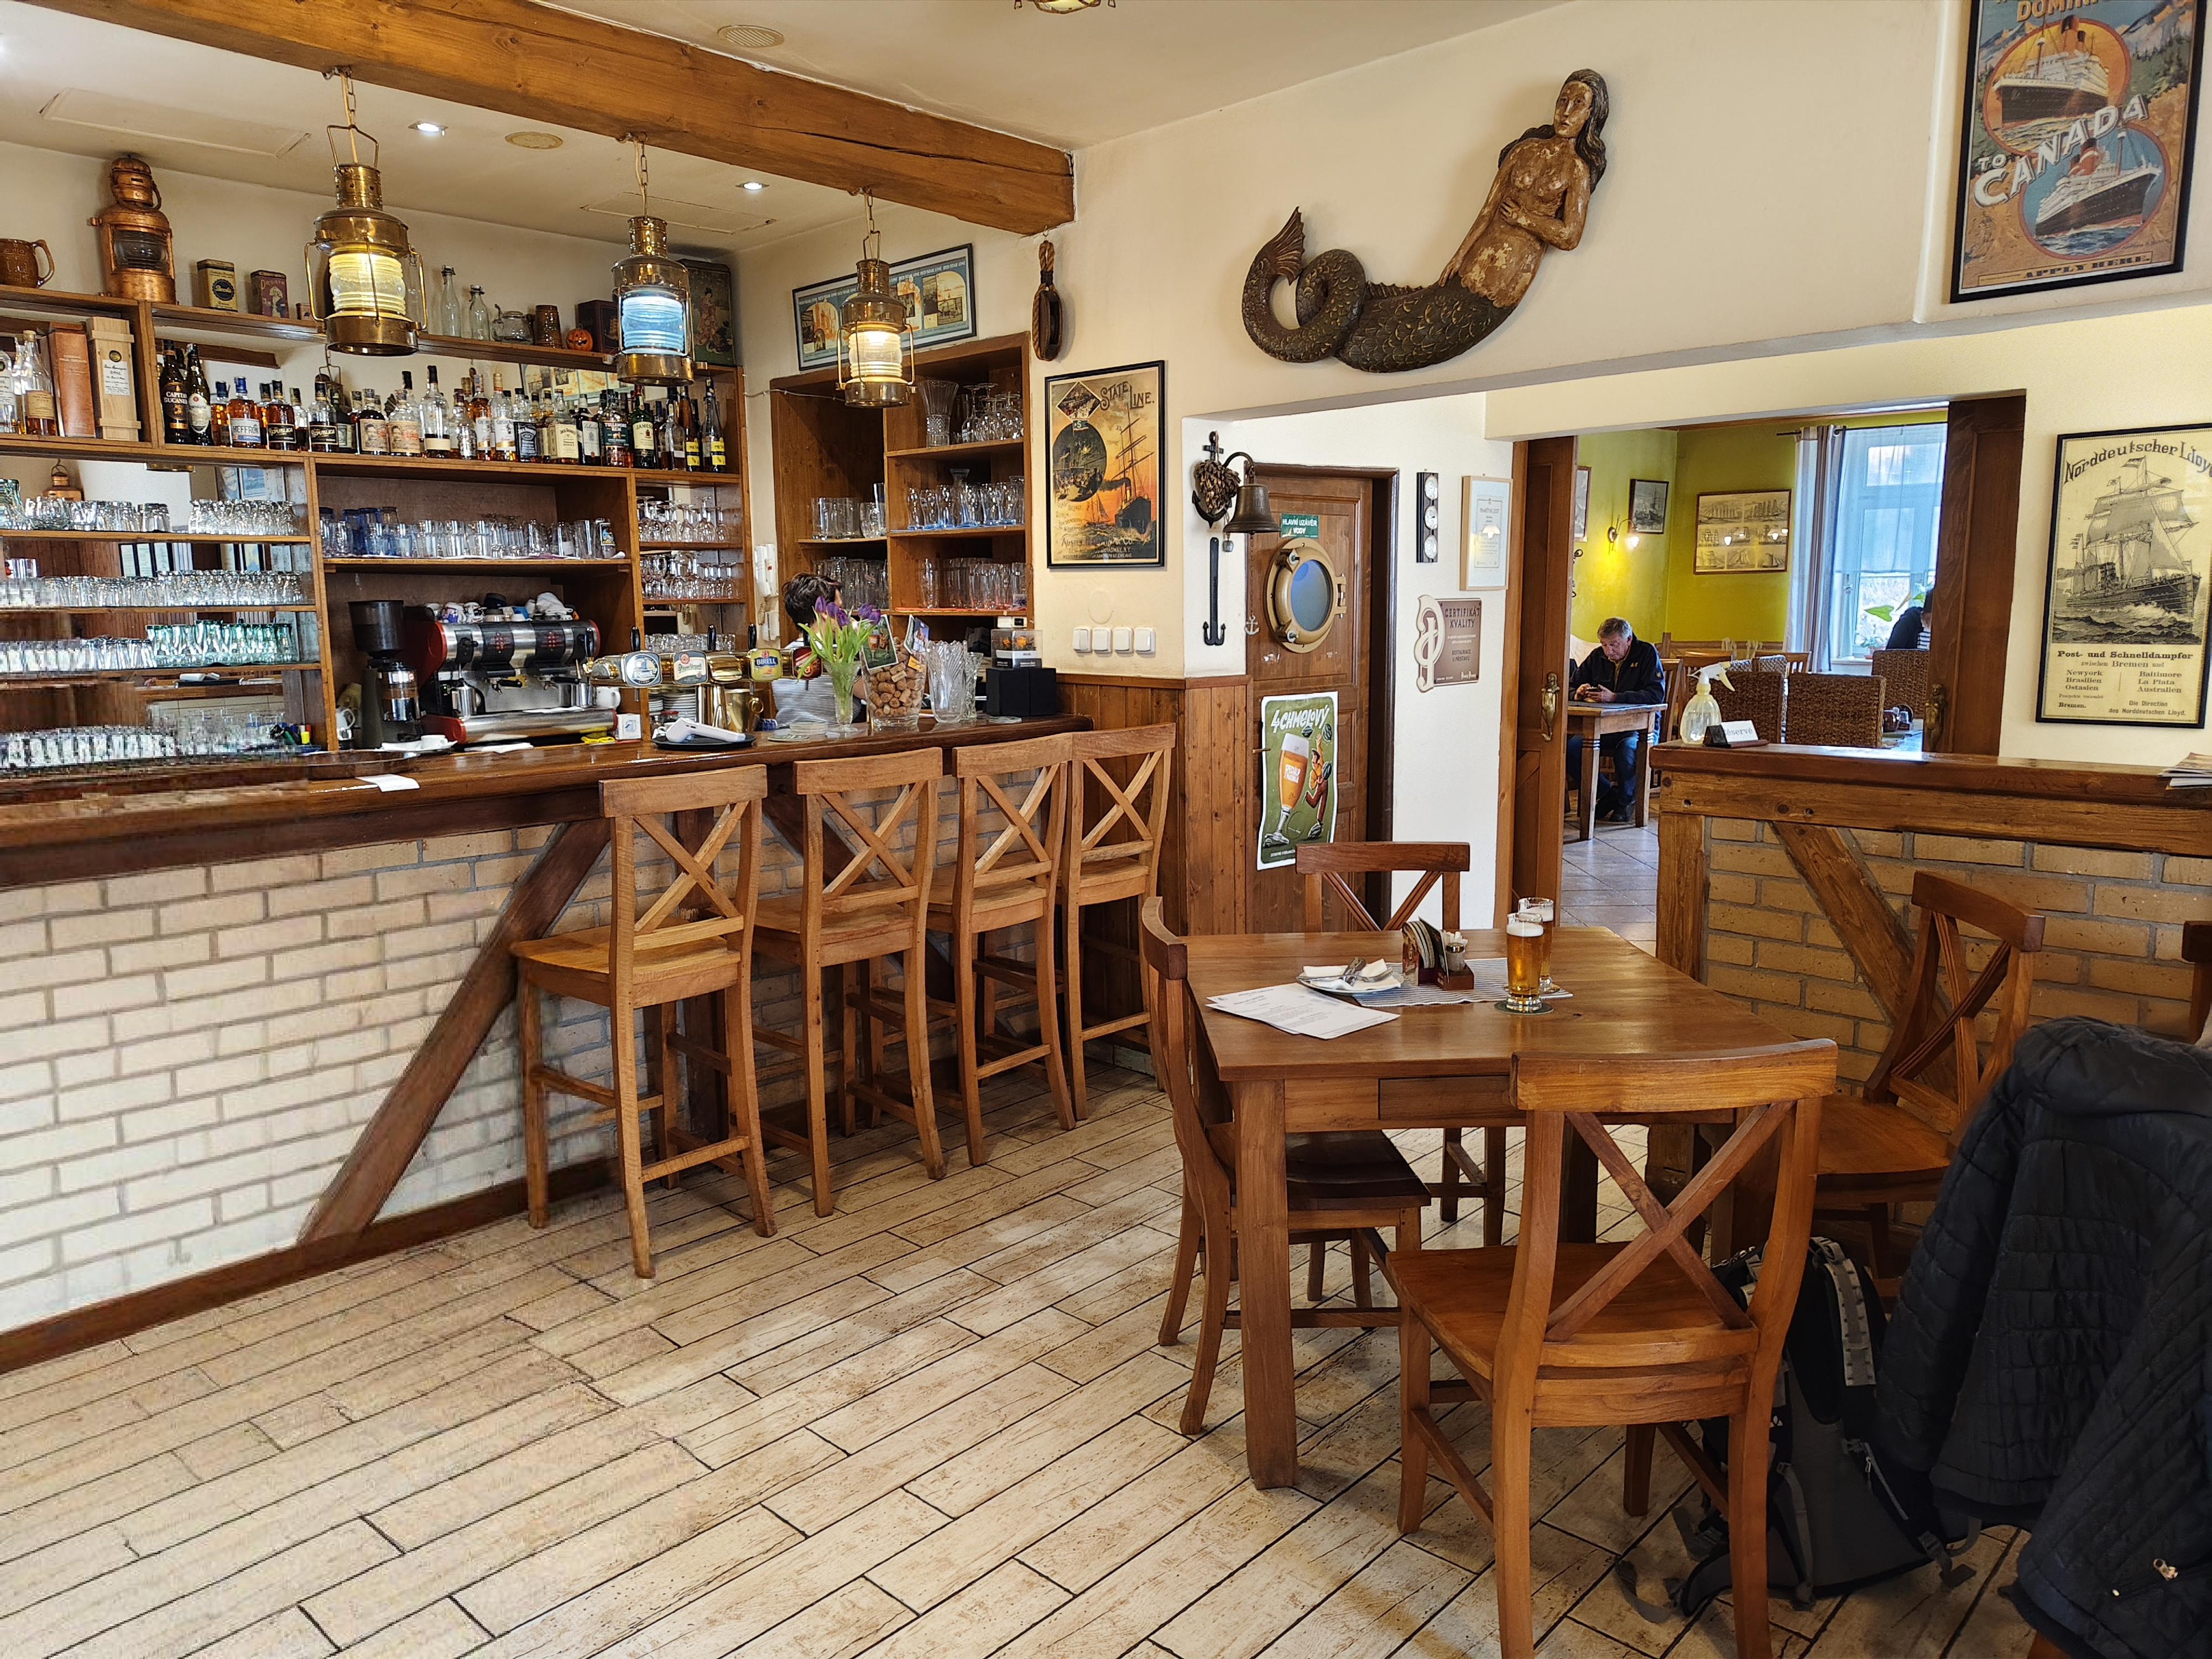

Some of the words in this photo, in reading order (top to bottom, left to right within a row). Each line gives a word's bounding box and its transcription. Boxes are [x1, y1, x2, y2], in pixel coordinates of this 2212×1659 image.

[1974, 93, 2149, 208] CANADA
[1978, 154, 2007, 172] TO
[1100, 381, 1129, 410] STATE
[2063, 439, 2179, 485] Norddeutscher
[1444, 606, 1480, 618] CERTIFIKÁT
[1449, 618, 1475, 629] KVALITY
[2110, 651, 2194, 660] Schnelldampfer
[1726, 727, 1753, 735] éservé
